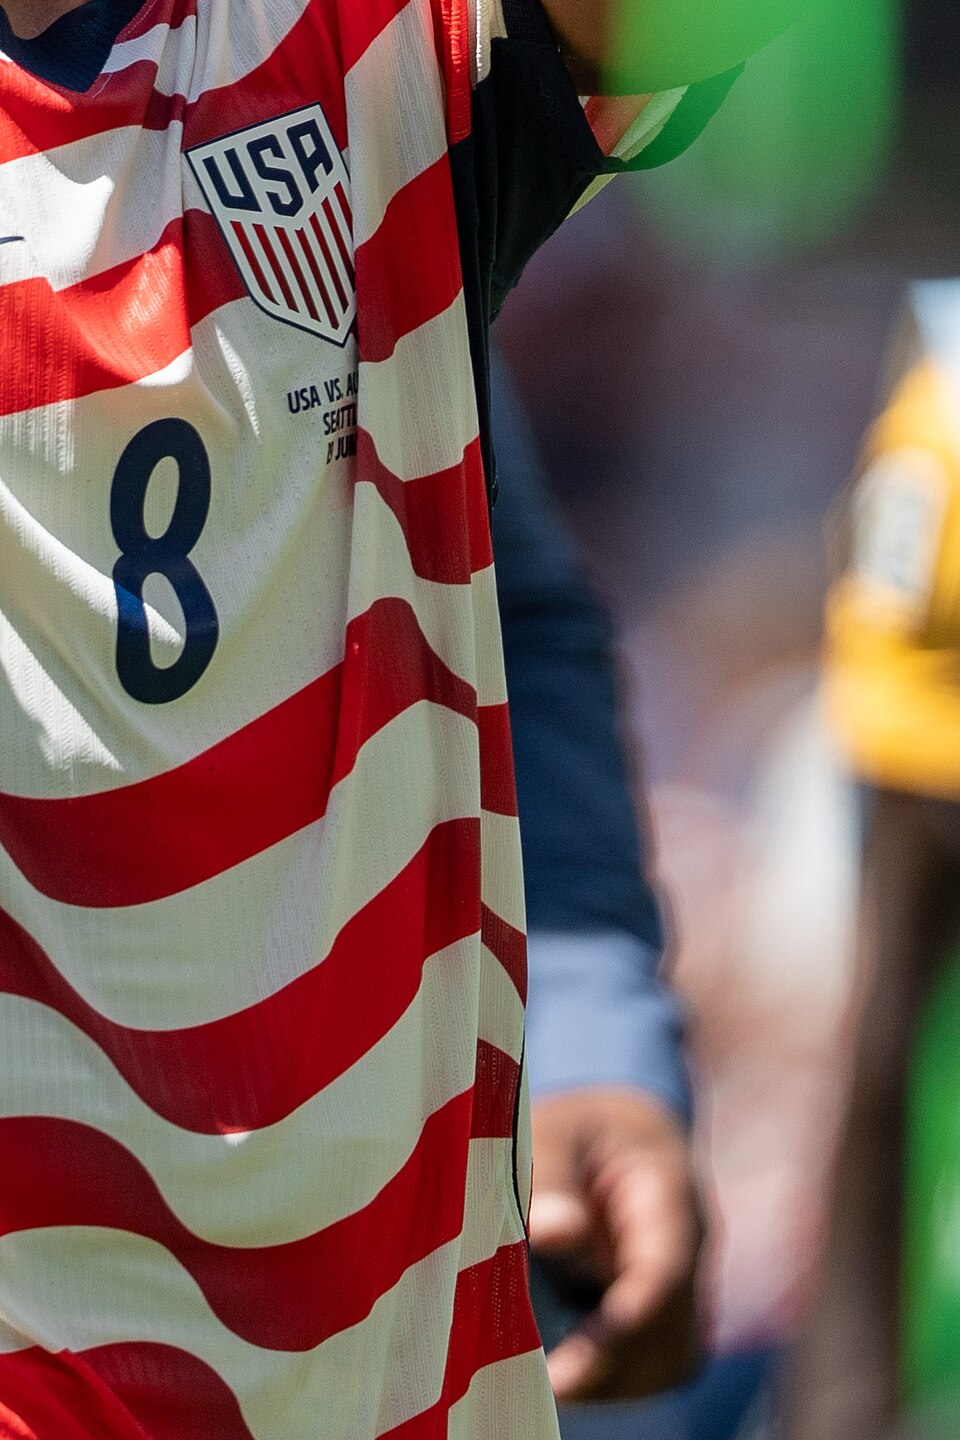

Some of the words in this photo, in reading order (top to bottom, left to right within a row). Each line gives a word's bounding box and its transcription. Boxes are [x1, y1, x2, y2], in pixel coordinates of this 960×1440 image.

[202, 118, 334, 217] USA
[287, 385, 321, 414] USA
[109, 417, 219, 704] 8
